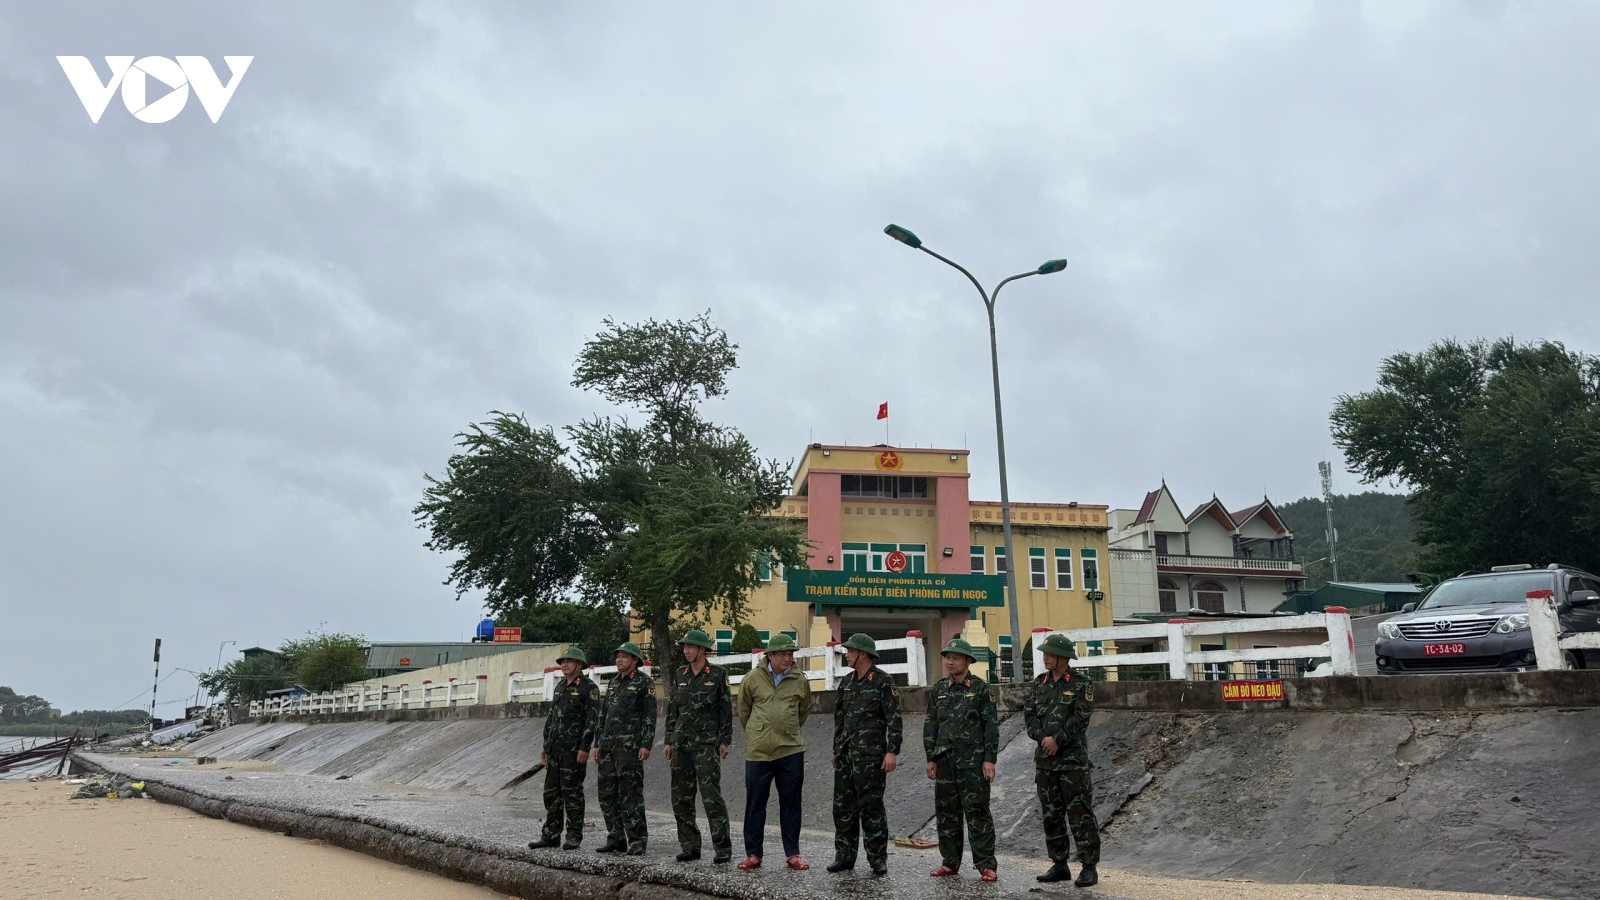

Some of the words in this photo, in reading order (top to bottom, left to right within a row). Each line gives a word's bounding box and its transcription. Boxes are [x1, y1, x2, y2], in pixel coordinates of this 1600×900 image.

[868, 576, 886, 584] BIÊN
[888, 577, 915, 585] PHÒNG
[805, 585, 832, 597] TRẠM
[834, 582, 857, 596] KIỂM
[860, 585, 883, 597] SOÁT
[886, 586, 907, 598] BIÊN
[909, 586, 940, 599] PHÒNG
[943, 587, 960, 599] MŨI
[963, 590, 987, 601] NGỌC
[1425, 643, 1463, 654] TC-34-02
[1223, 683, 1239, 697] CẤM
[1251, 684, 1265, 698] NEO
[1266, 682, 1281, 699] ĐẬU
